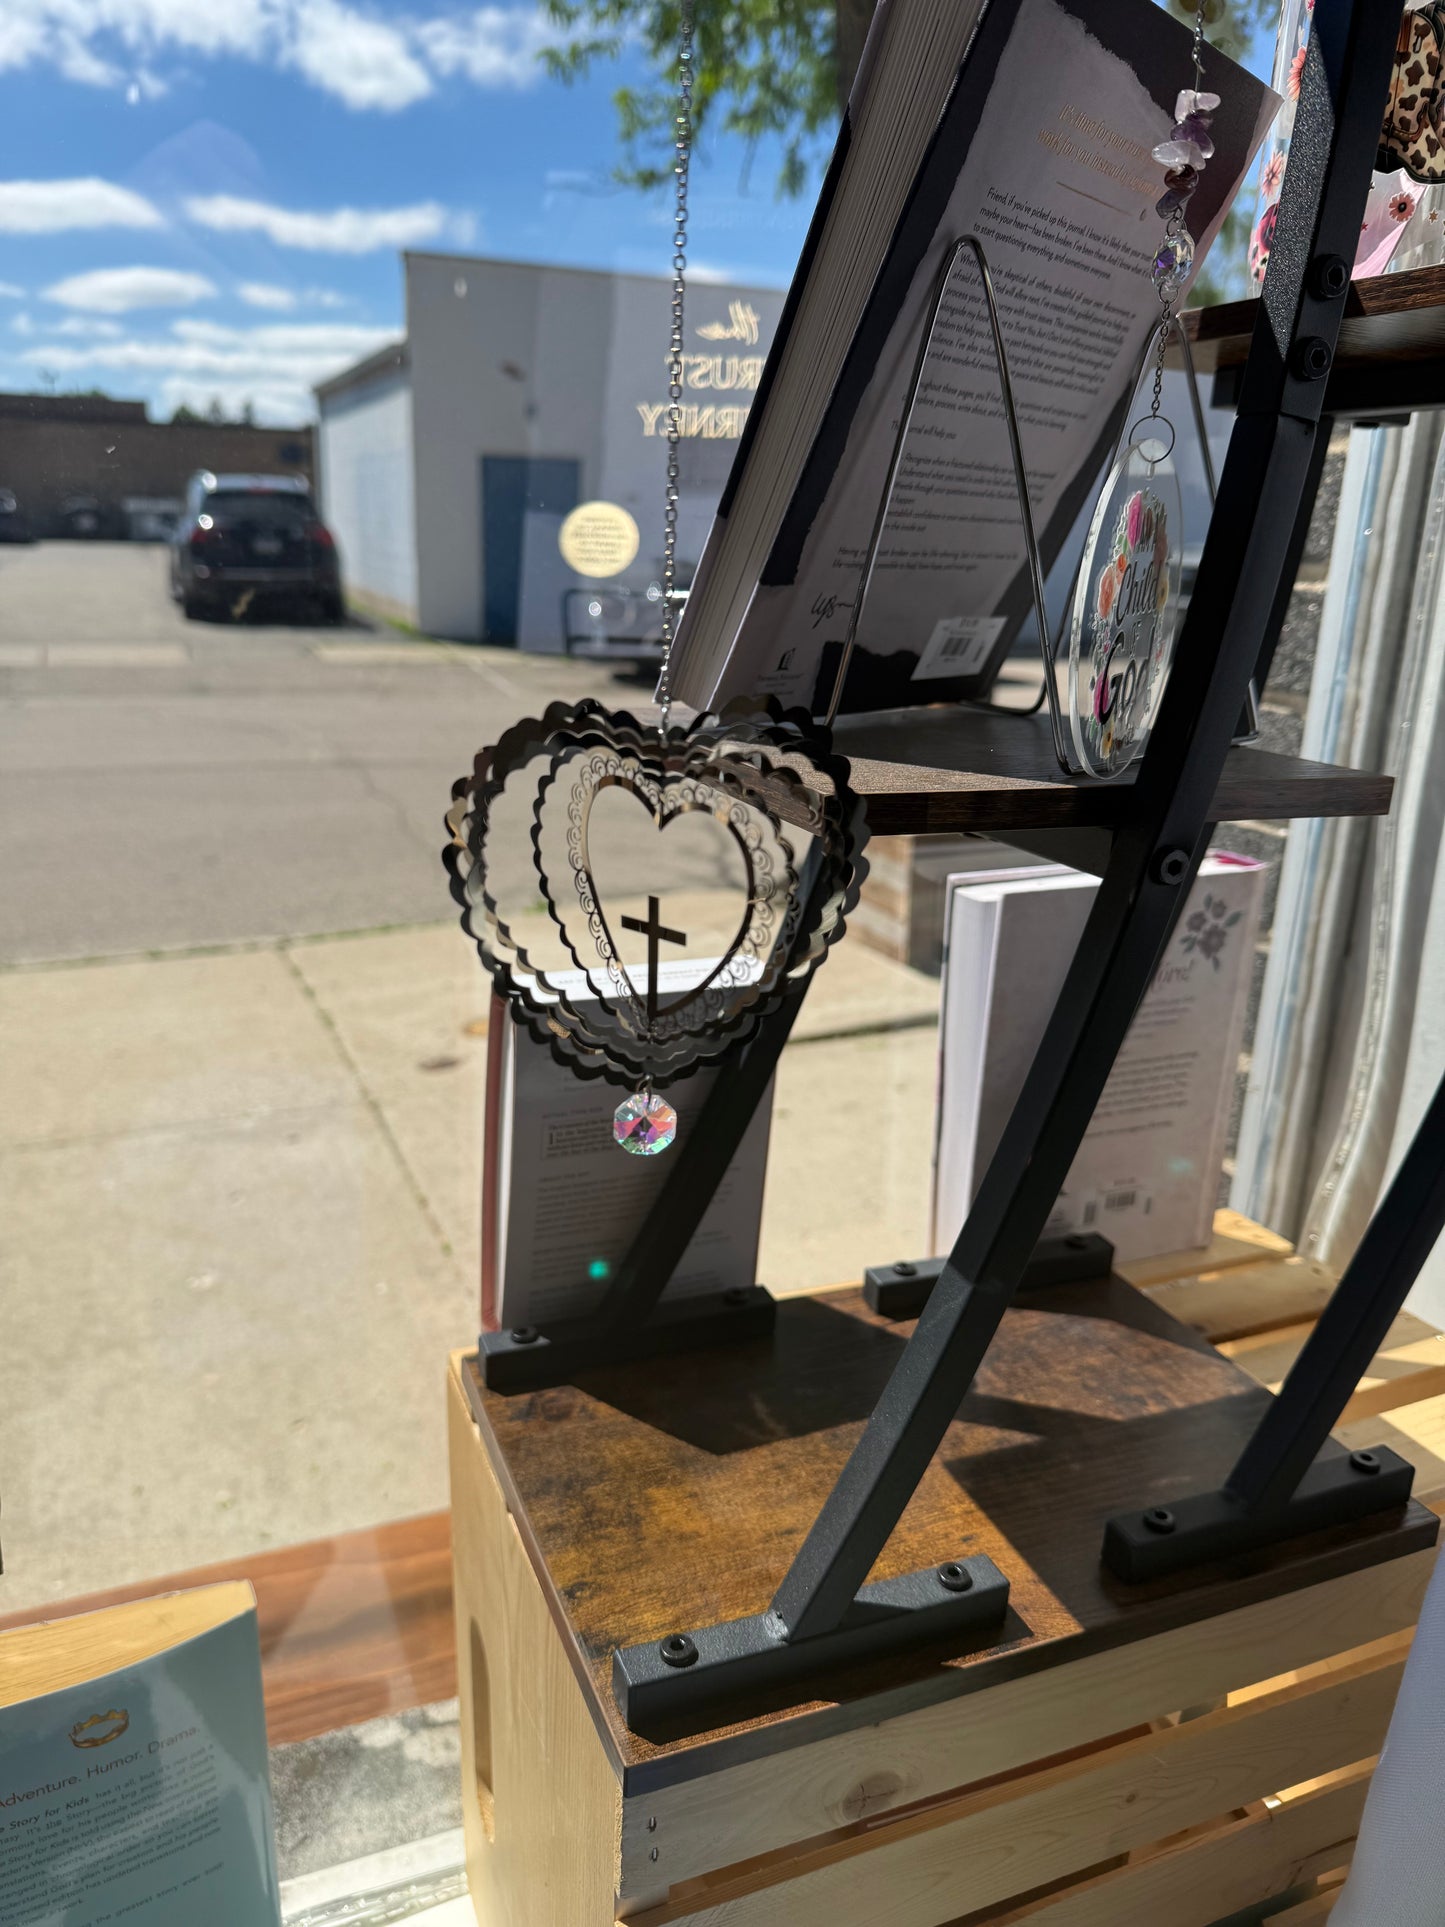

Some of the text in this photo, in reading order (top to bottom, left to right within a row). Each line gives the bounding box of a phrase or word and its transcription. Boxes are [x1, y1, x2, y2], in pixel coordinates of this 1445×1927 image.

[987, 186, 1008, 205] Friend,
[1012, 201, 1032, 214] you've
[1030, 207, 1052, 221] picked
[980, 207, 1001, 220] maybe
[1055, 233, 1071, 248] broken.
[981, 226, 997, 237] start
[993, 232, 1028, 252] questioning
[1116, 559, 1161, 627] Child
[87, 1752, 143, 1778] Humor.
[148, 1727, 200, 1754] Drama.
[10, 1814, 40, 1830] Story
